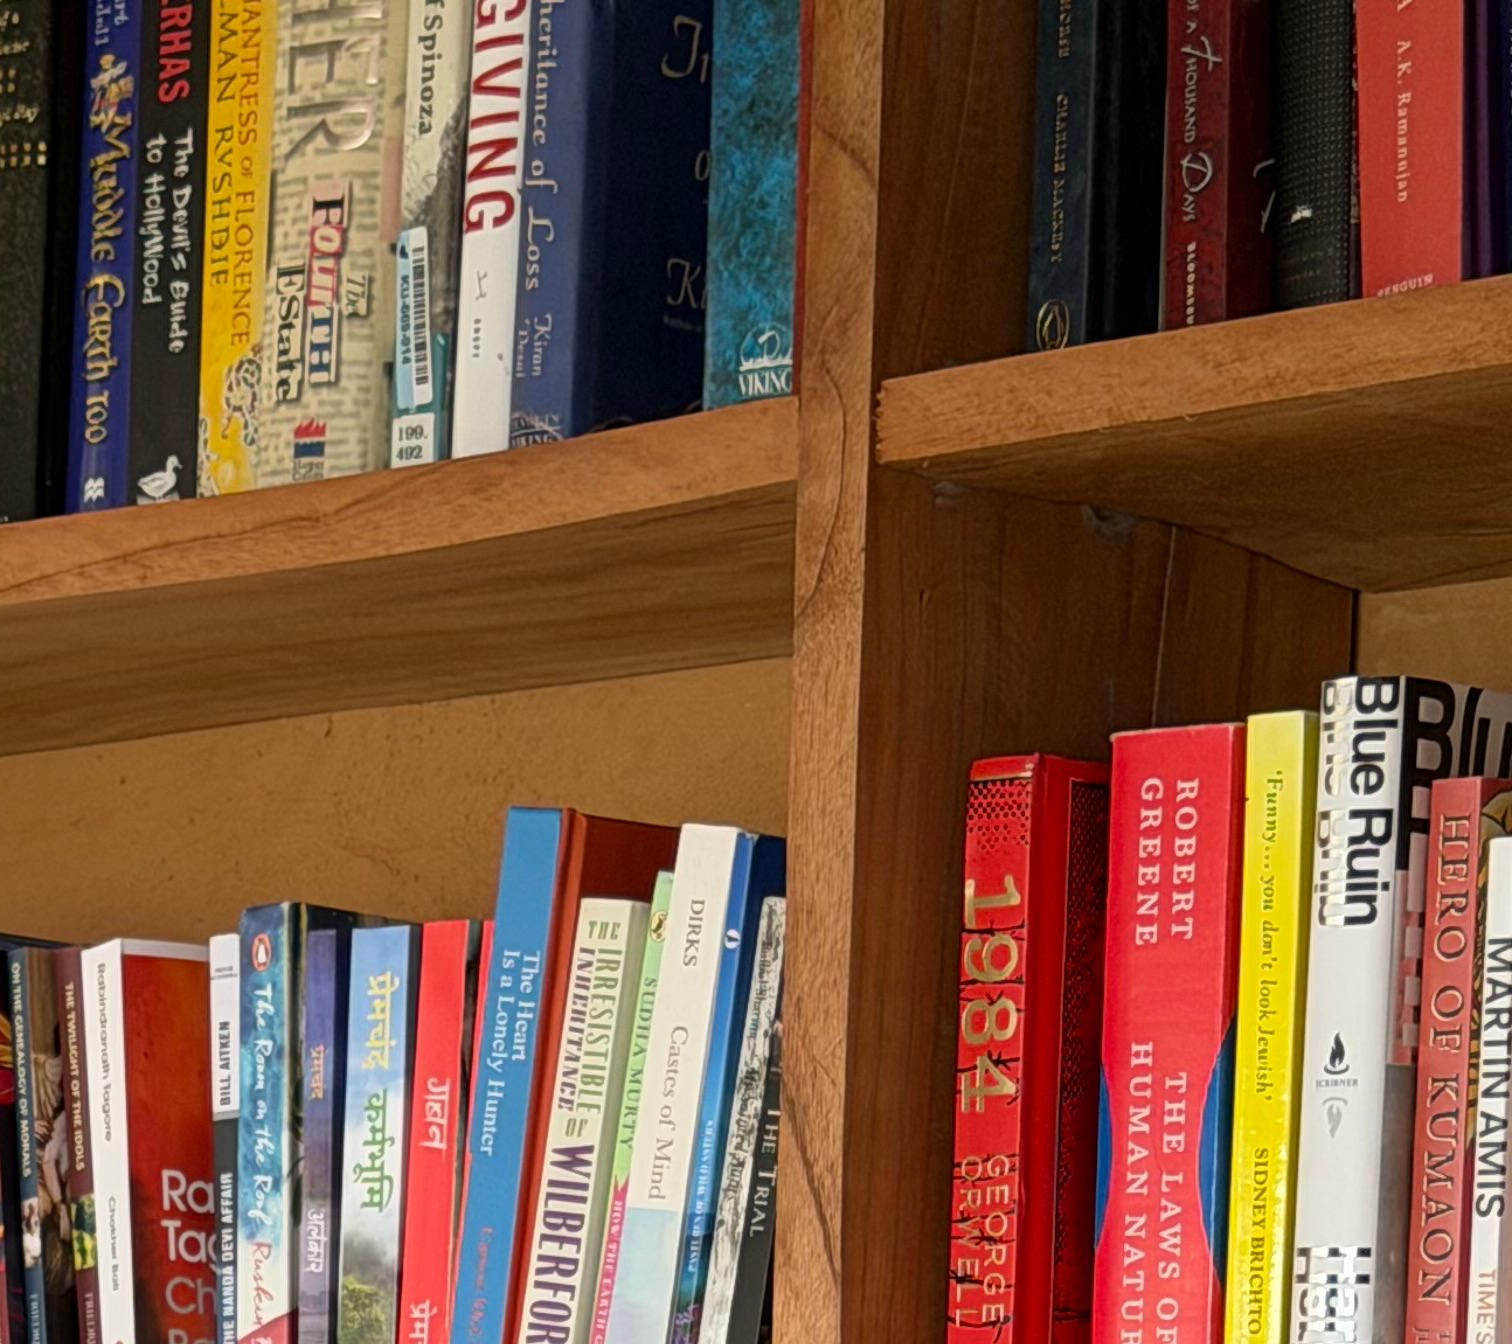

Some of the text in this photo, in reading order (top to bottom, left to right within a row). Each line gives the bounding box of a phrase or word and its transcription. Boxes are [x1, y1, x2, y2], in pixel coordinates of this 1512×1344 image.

[417, 15, 445, 136] Spinoza
[231, 192, 255, 347] FLORENCE
[524, 160, 559, 290] of Loss
[530, 315, 553, 377] Kiran
[1135, 777, 1165, 946] GREENE
[1170, 778, 1201, 940] ROBERT
[1343, 677, 1399, 926] Blue Ruin
[512, 950, 540, 1061] The Heart
[683, 899, 705, 968] DIRKS
[353, 971, 399, 1214] प्रेमचंद कर्मभूमि
[480, 949, 520, 1157] Is a Lonely Hunter
[558, 947, 595, 1112] INHERITANCE
[576, 948, 623, 1114] IRRESISTIBLE
[619, 977, 657, 1150] SUDHA MURTY
[1418, 814, 1472, 1305] HERO OF KUMAON
[419, 1077, 451, 1160] गबन
[647, 1026, 689, 1200] Castes of Mind
[748, 1107, 781, 1237] THE TRIAL
[1124, 1042, 1154, 1196] HUMAN
[1161, 1071, 1188, 1154] THE
[1475, 1111, 1509, 1217] AMIS
[253, 1242, 272, 1328] Ruskin
[305, 1209, 326, 1273] अलंकार
[955, 1155, 982, 1328] ORWELL
[980, 1153, 1011, 1325] GEORGE
[1157, 1173, 1185, 1279] LAWS
